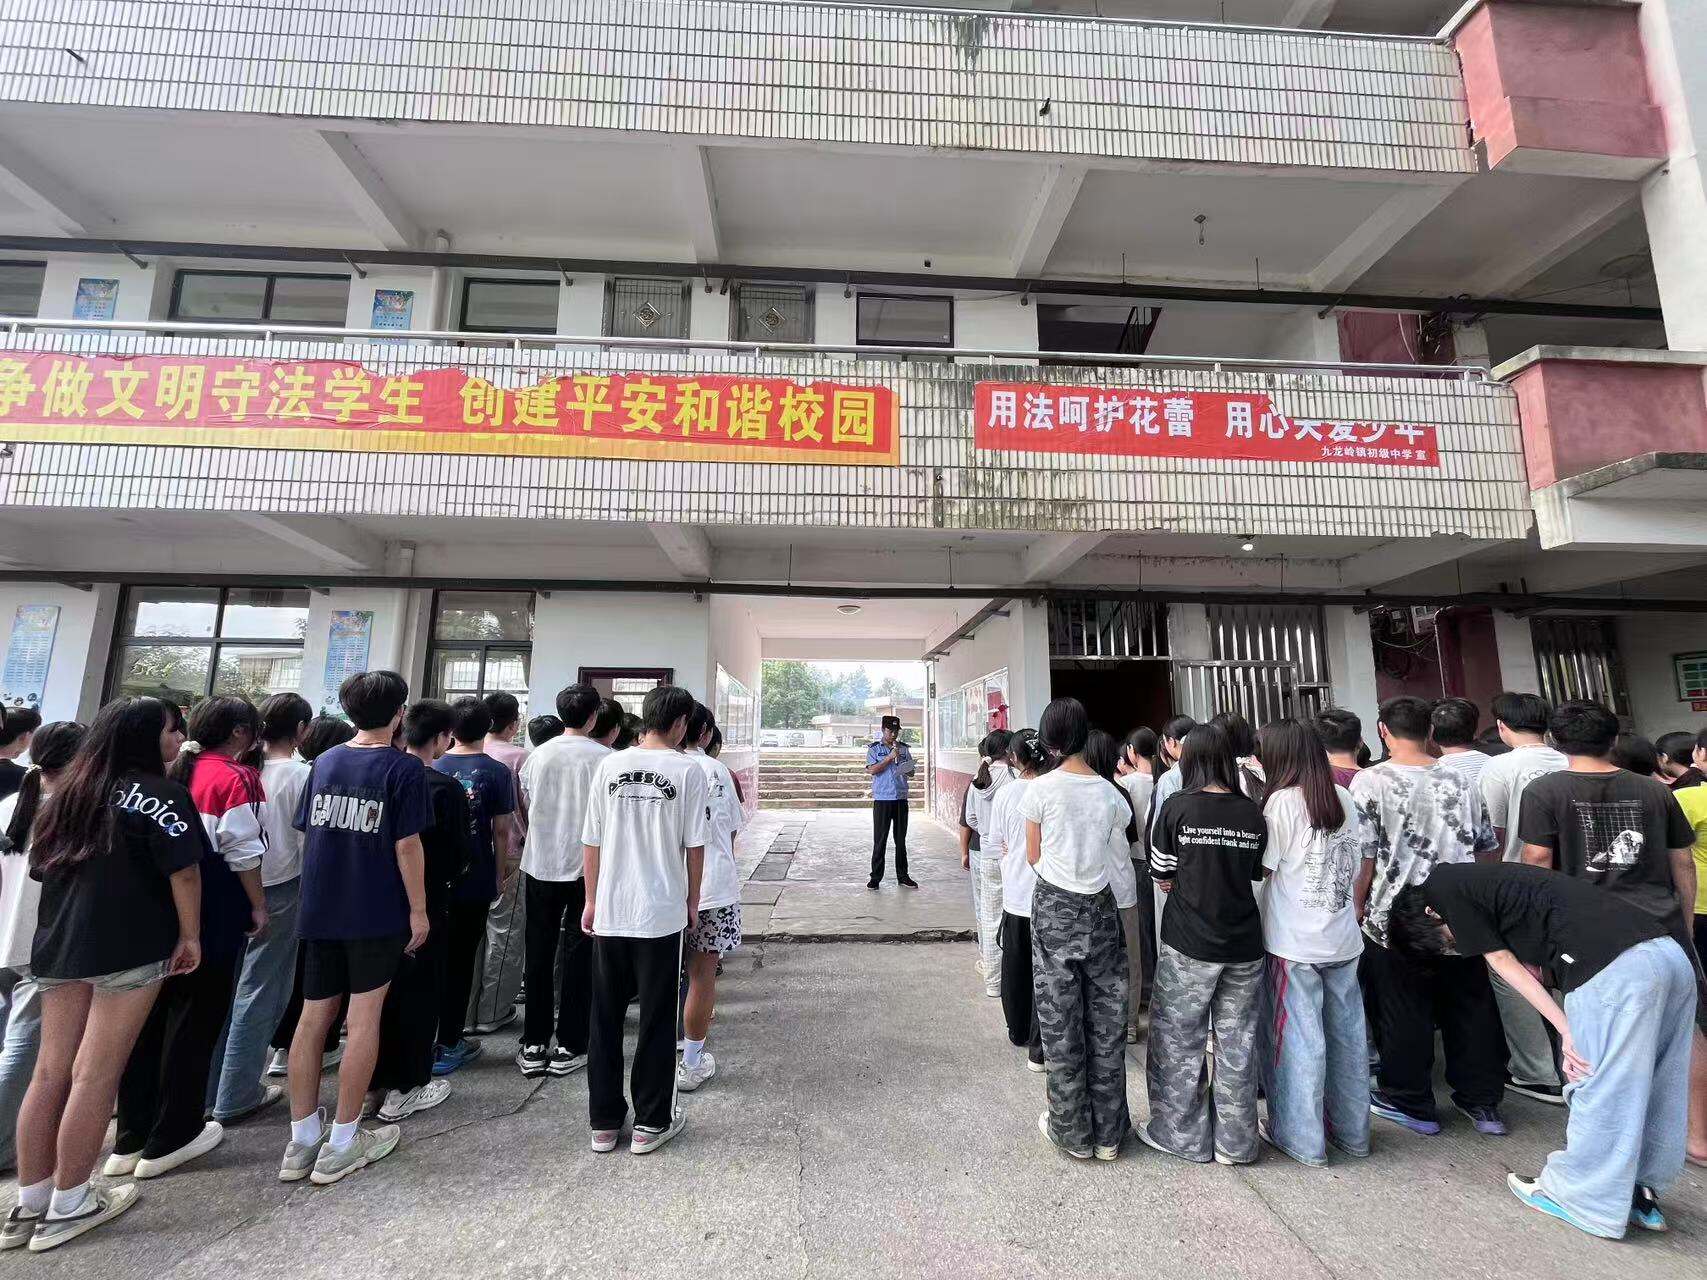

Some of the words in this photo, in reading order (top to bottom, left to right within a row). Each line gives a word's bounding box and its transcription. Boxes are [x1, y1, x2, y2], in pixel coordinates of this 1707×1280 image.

[0, 360, 424, 424] 争做文明守法学生
[459, 375, 875, 446] 创建平安和谐校园
[987, 390, 1195, 438] 用法呵护花蕾
[1191, 836, 1221, 846] confident
[1221, 837, 1238, 848] frank
[1197, 827, 1223, 836] yourself
[1223, 828, 1236, 837] into
